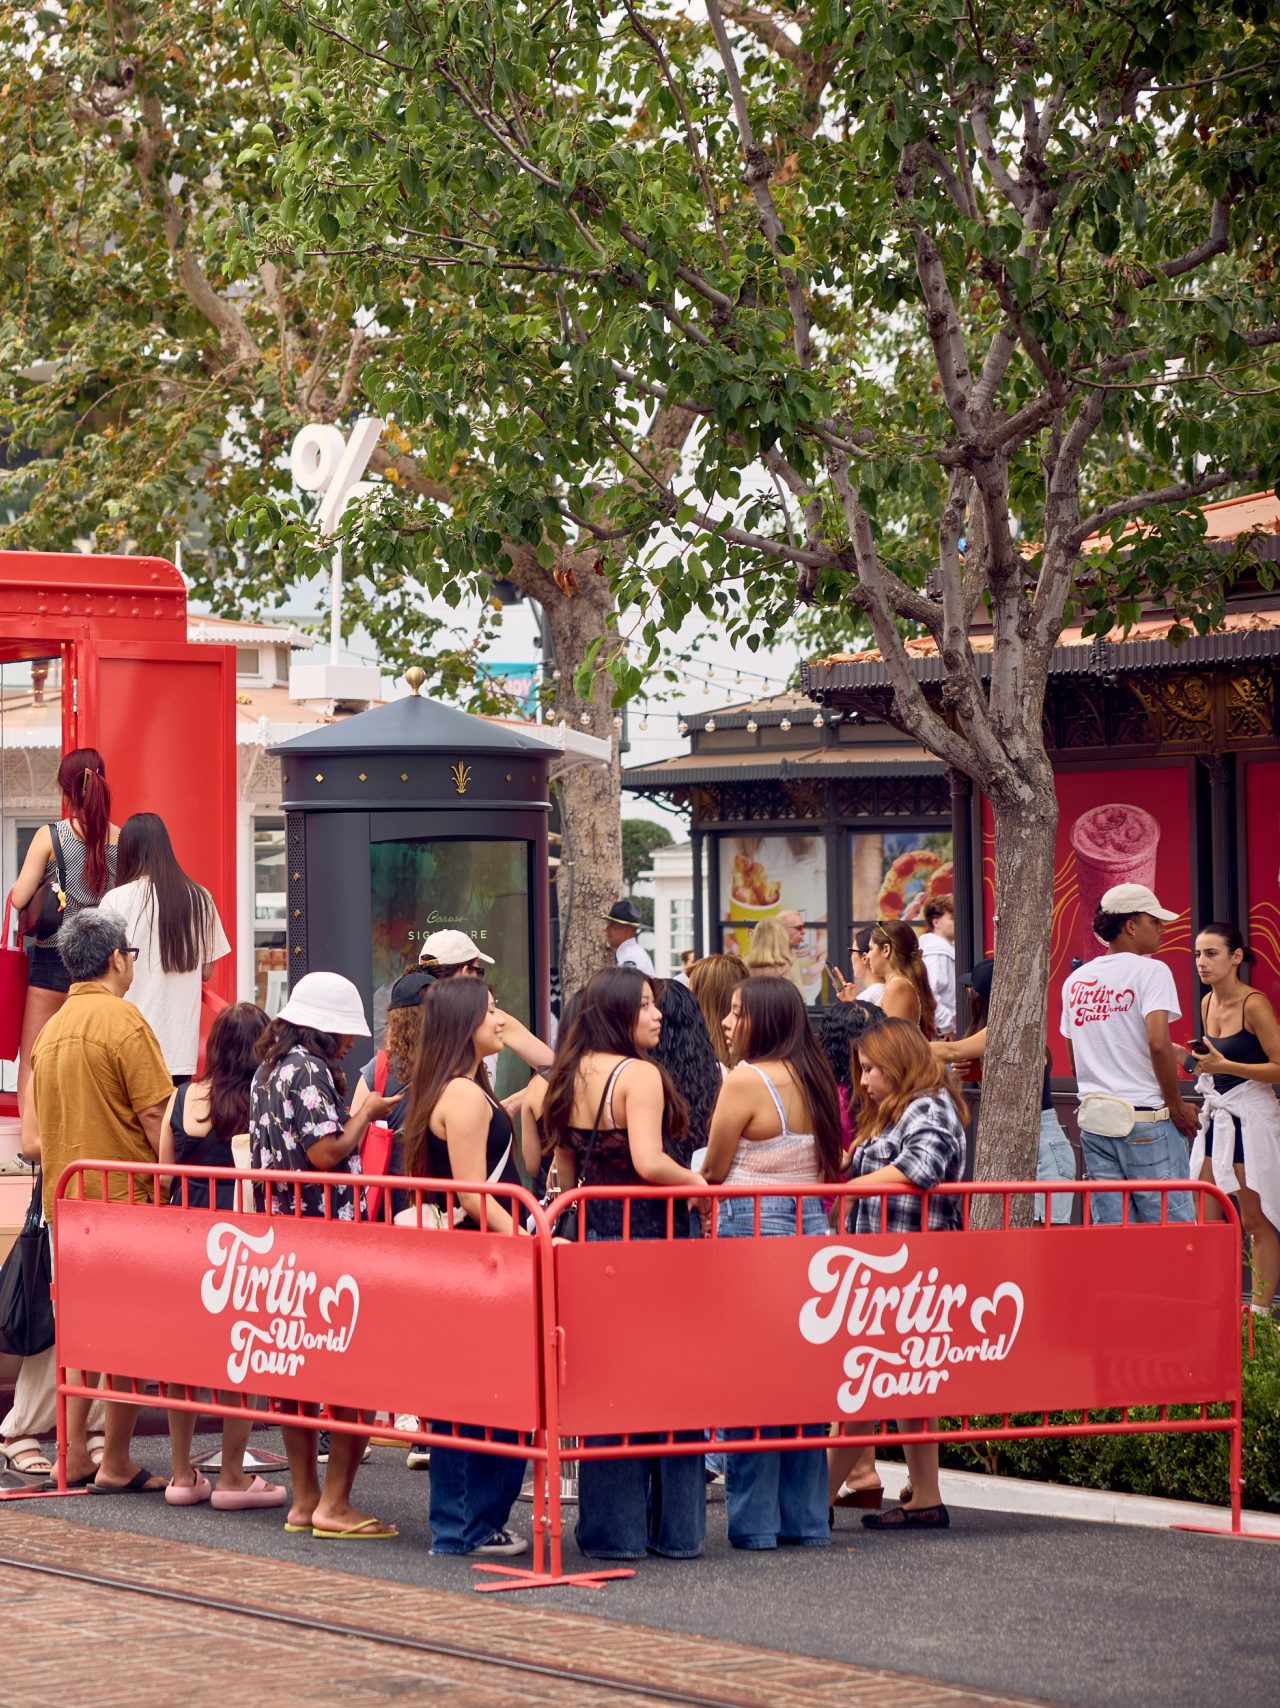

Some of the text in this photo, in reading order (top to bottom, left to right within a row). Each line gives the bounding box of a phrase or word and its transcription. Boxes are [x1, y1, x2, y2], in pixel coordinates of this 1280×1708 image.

[408, 929, 488, 941] SIGRE
[426, 910, 469, 924] Caruso
[1070, 977, 1114, 1008] Tirtir
[1093, 1004, 1129, 1014] World
[1074, 1007, 1110, 1027] Tour
[200, 1221, 317, 1319] Tirtir
[798, 1242, 968, 1345] Tirtir
[226, 1320, 306, 1384] Tour
[270, 1317, 347, 1353] World
[900, 1333, 1008, 1370] World
[836, 1345, 950, 1414] Tour
